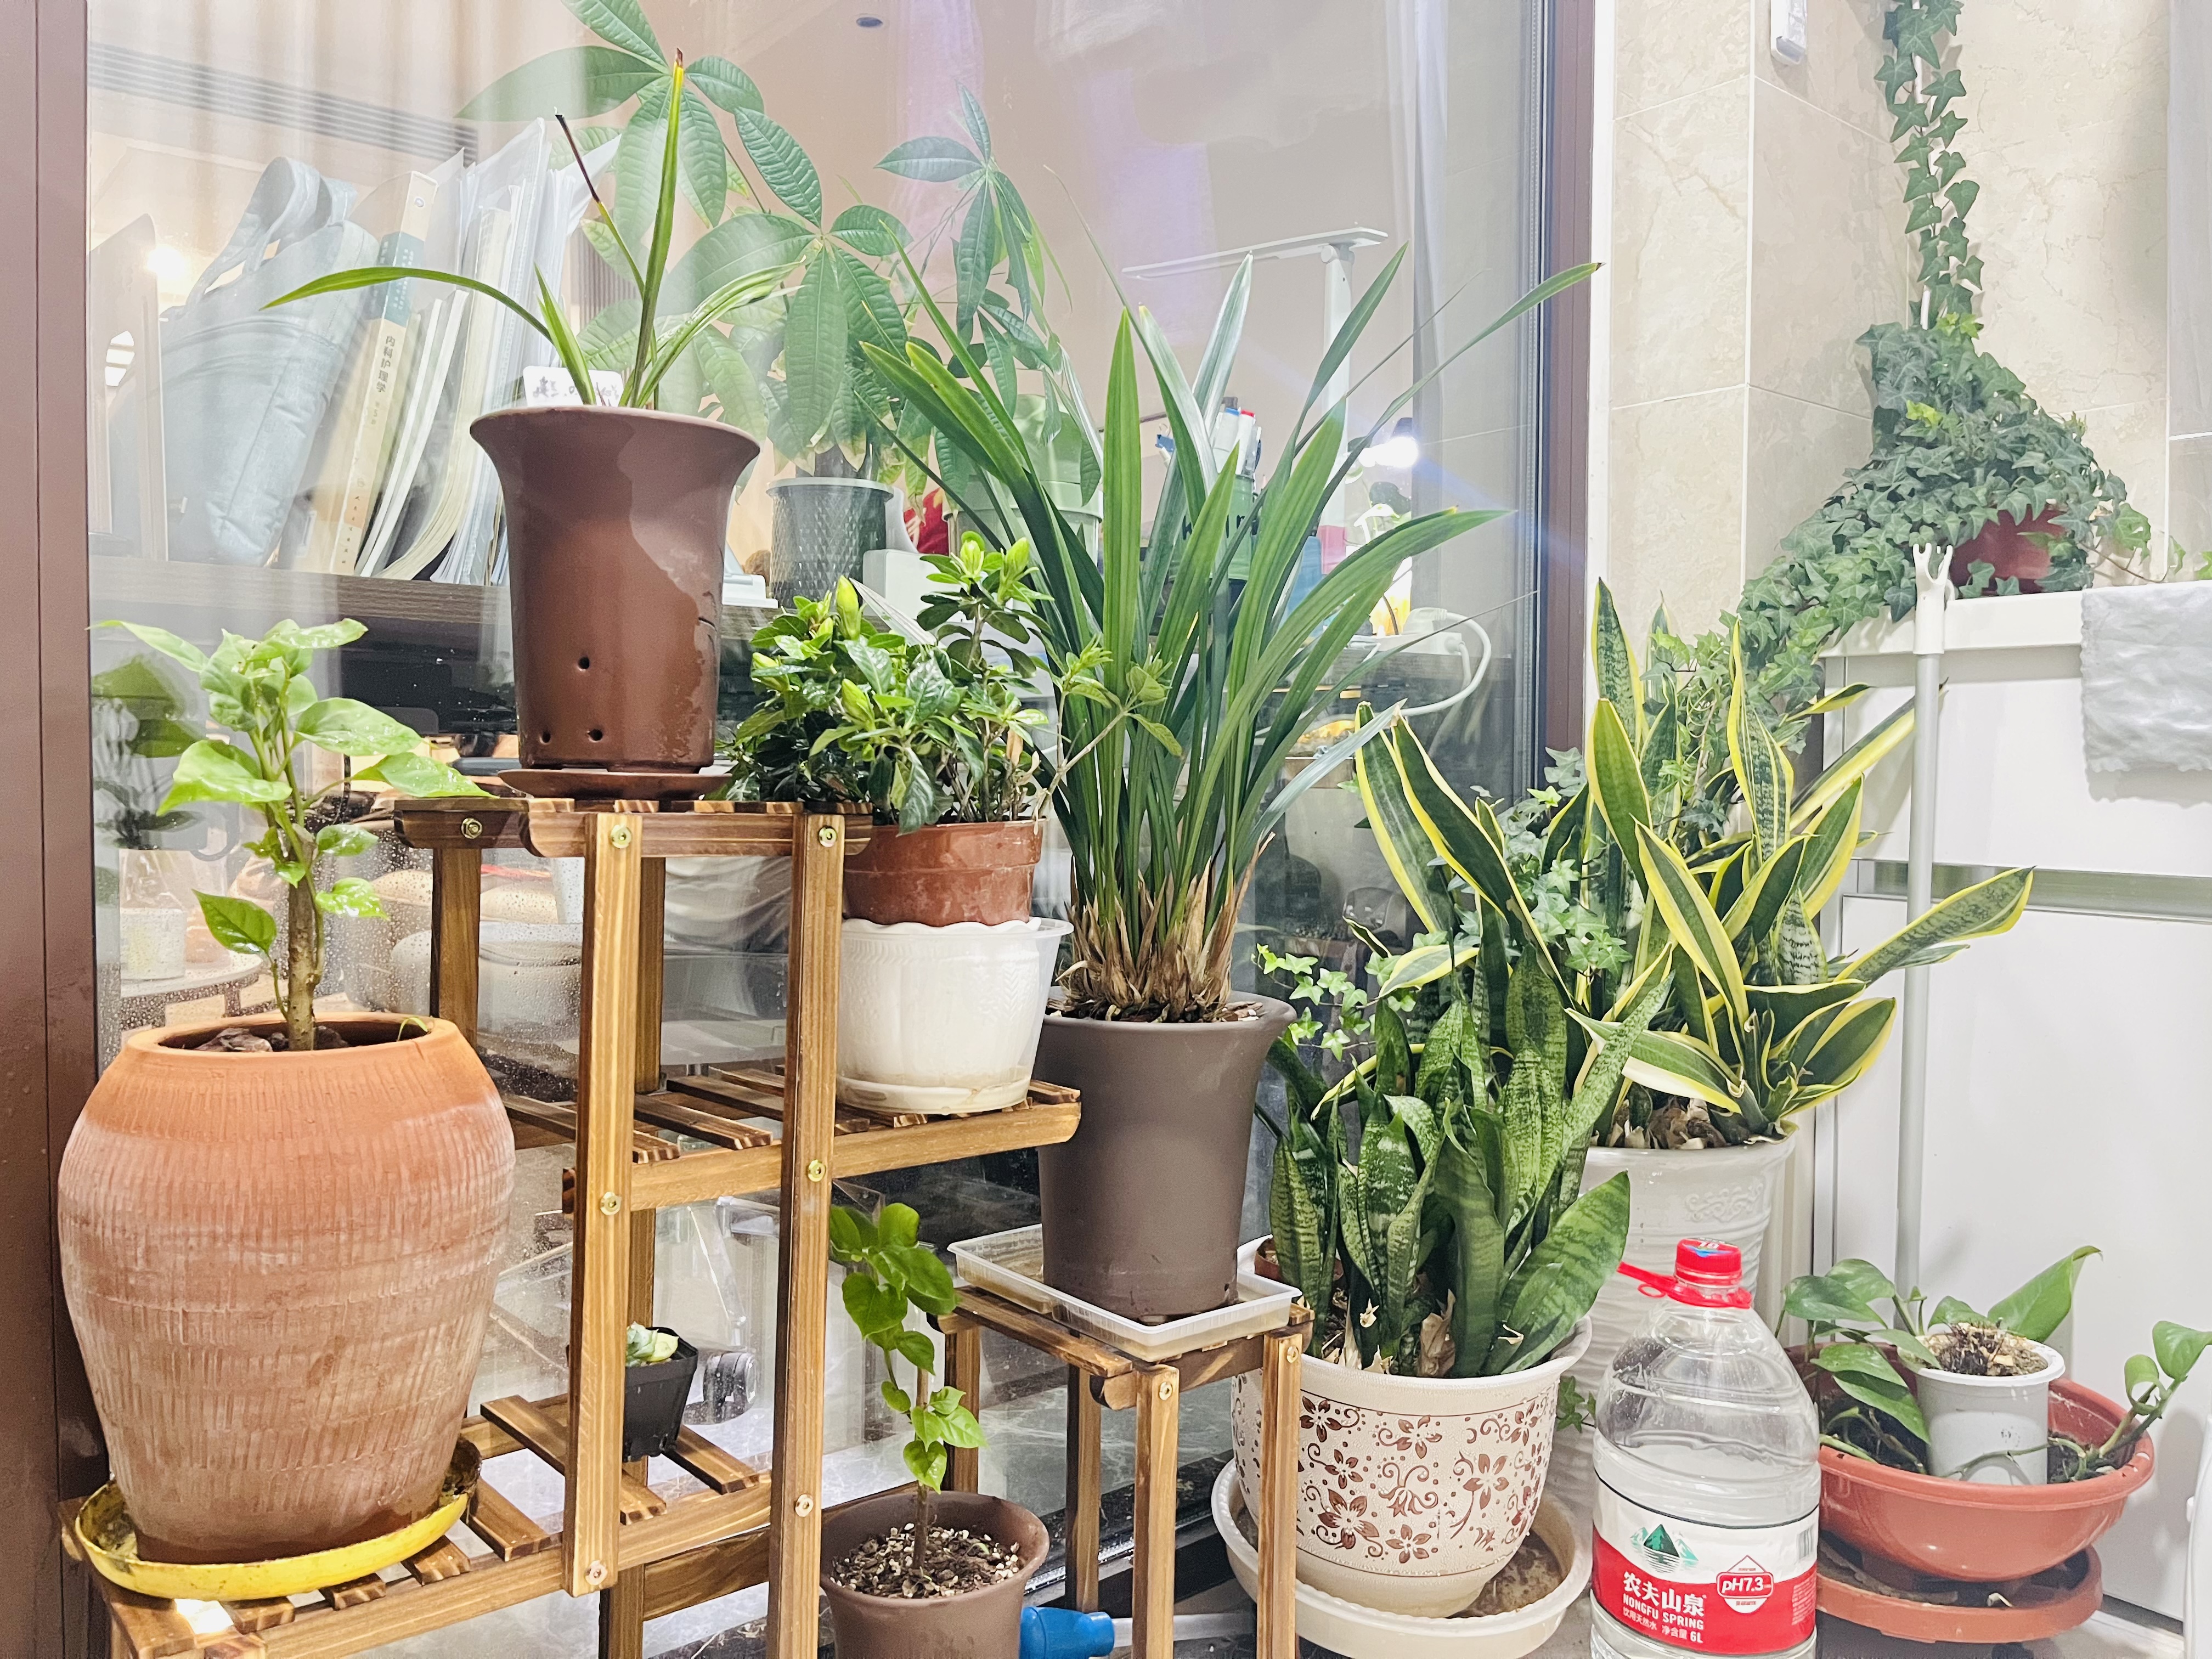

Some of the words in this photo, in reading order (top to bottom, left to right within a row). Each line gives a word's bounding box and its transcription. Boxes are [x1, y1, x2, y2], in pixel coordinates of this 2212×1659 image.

[376, 335, 396, 393] 内科护理学
[1623, 1571, 1705, 1617] 农夫山泉
[1623, 1593, 1659, 1620] NONGFU
[1662, 1612, 1704, 1630] SPRING
[1690, 1631, 1703, 1644] 6L
